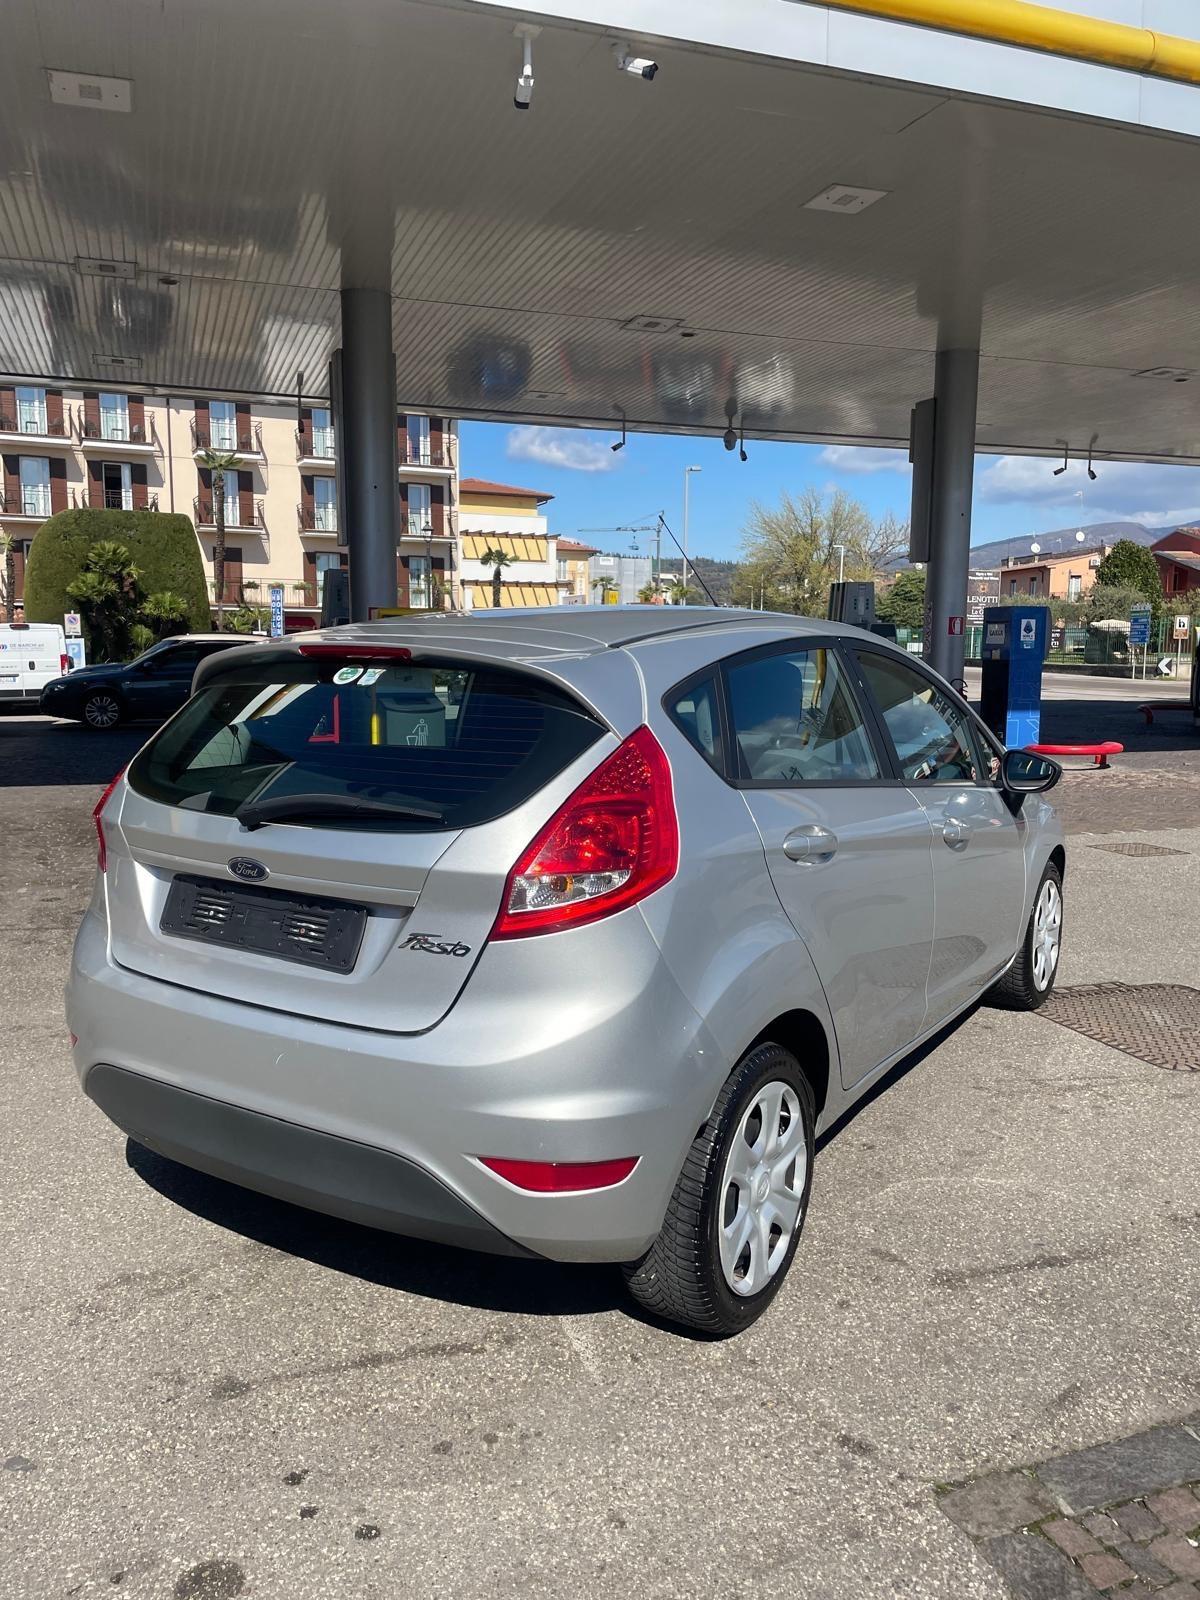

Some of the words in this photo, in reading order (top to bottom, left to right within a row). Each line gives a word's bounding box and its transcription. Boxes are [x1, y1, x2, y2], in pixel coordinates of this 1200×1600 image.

[967, 595, 998, 603] LENOTTI
[236, 862, 258, 877] Ford
[397, 932, 472, 958] Fiesta
